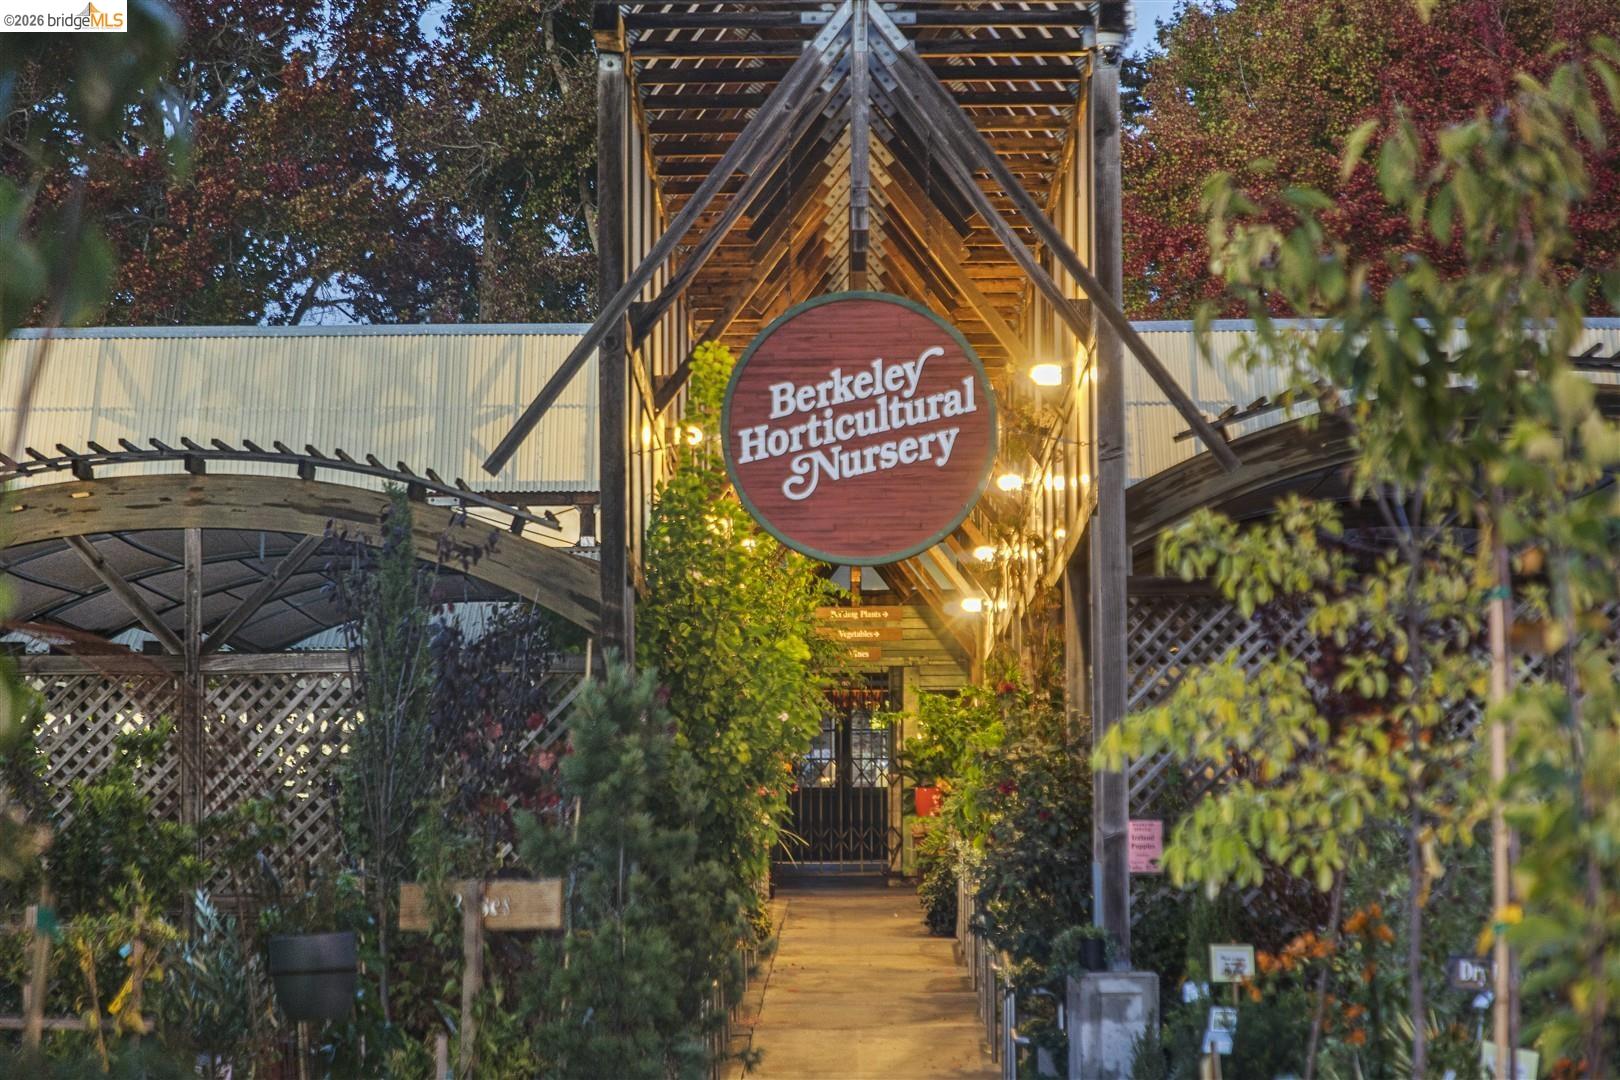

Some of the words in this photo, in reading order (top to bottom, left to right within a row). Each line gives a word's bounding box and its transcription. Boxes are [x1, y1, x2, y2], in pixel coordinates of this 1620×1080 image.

[769, 346, 944, 419] Berkeley
[738, 376, 977, 464] Horticultural
[782, 428, 959, 500] Nursery
[838, 629, 873, 639] Vegetables
[860, 610, 881, 618] Plants
[1459, 959, 1487, 987] Dry
